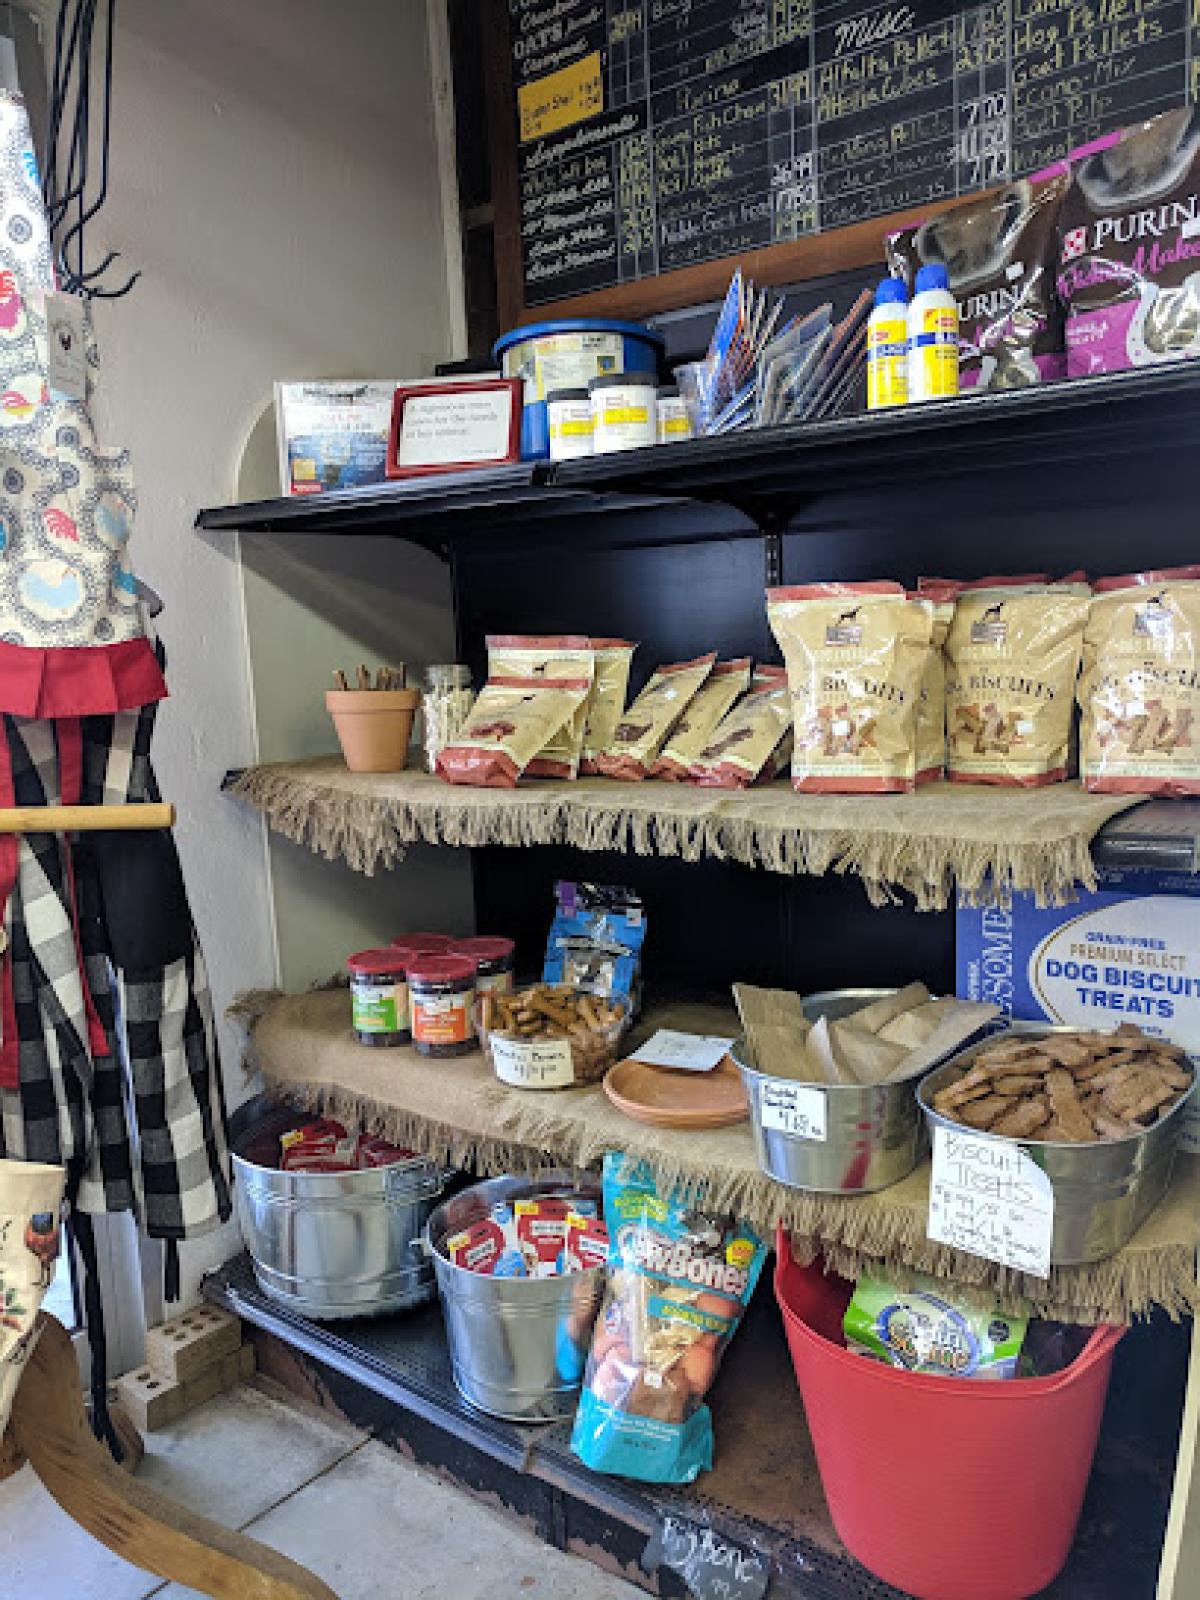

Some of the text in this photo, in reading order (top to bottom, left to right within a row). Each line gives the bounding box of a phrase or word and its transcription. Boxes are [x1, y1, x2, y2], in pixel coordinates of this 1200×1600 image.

[1014, 20, 1058, 54] Hog
[1046, 958, 1099, 983] DOG
[1070, 943, 1187, 971] PREMIUM SELECT
[1076, 987, 1175, 1019] TREATS
